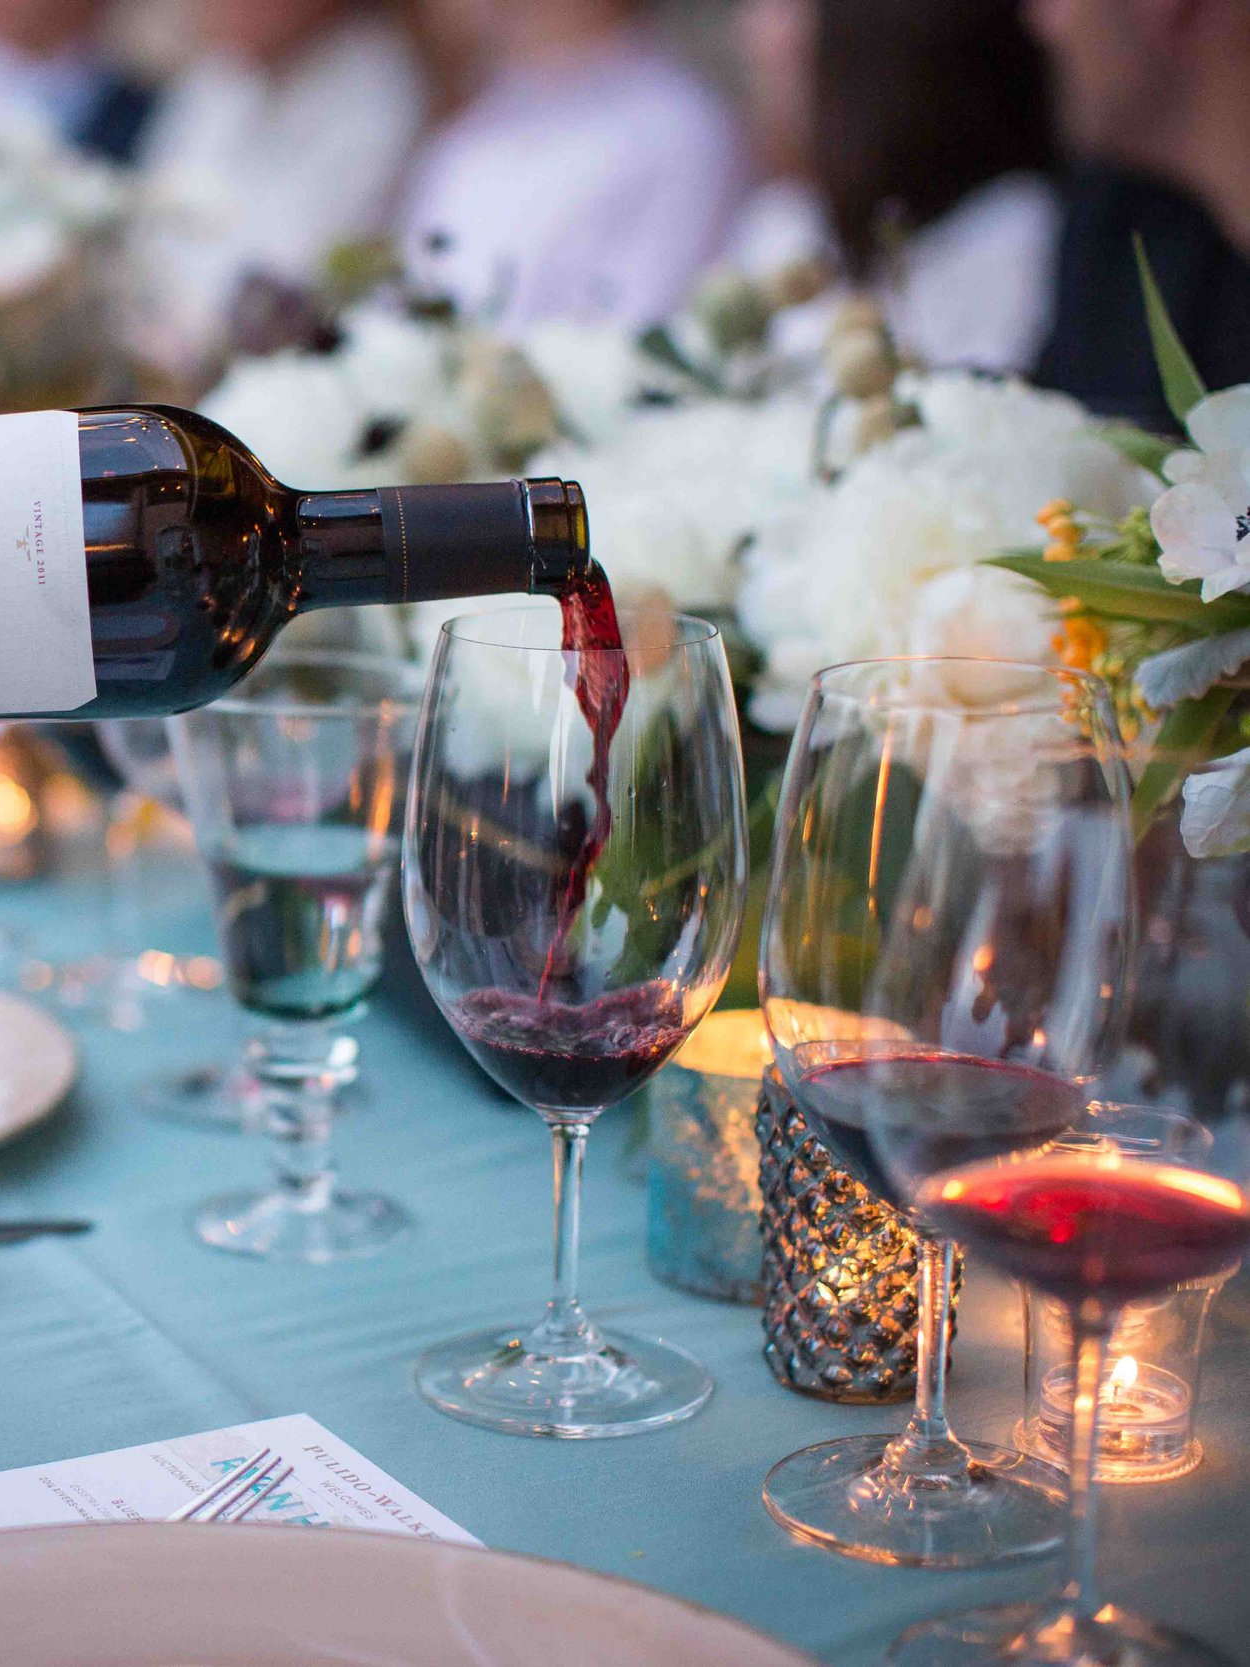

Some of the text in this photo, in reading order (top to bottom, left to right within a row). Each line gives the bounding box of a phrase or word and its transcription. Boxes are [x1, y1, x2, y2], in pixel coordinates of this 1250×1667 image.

[33, 501, 46, 585] VINTAGE 2011
[149, 1453, 206, 1496] AUCTION NAP
[303, 1444, 440, 1541] PULIDO-WALKE
[321, 1479, 378, 1521] WELCOMES
